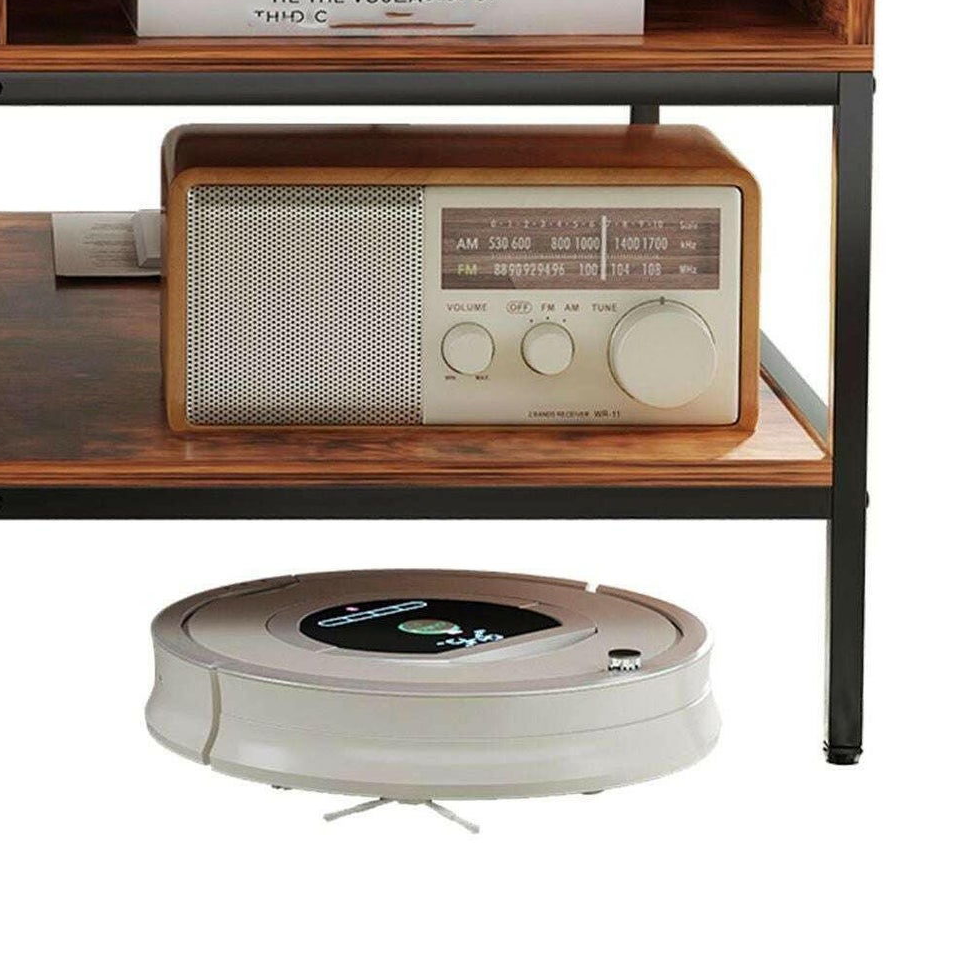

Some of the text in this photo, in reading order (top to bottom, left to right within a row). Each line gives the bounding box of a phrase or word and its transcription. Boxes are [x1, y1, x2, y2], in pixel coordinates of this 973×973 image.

[456, 237, 479, 250] AM
[489, 236, 508, 250] 530
[511, 236, 531, 250] 600
[550, 236, 571, 250] 800
[575, 236, 600, 250] 1000
[615, 236, 640, 250] 1400
[642, 236, 668, 250] 1700
[457, 263, 477, 275] FM
[579, 263, 599, 276] 100
[610, 263, 629, 276] 104
[642, 263, 662, 276] 108
[447, 303, 487, 312] VOLUME
[509, 303, 579, 312] OFF FM AM
[592, 303, 618, 312] TUNE
